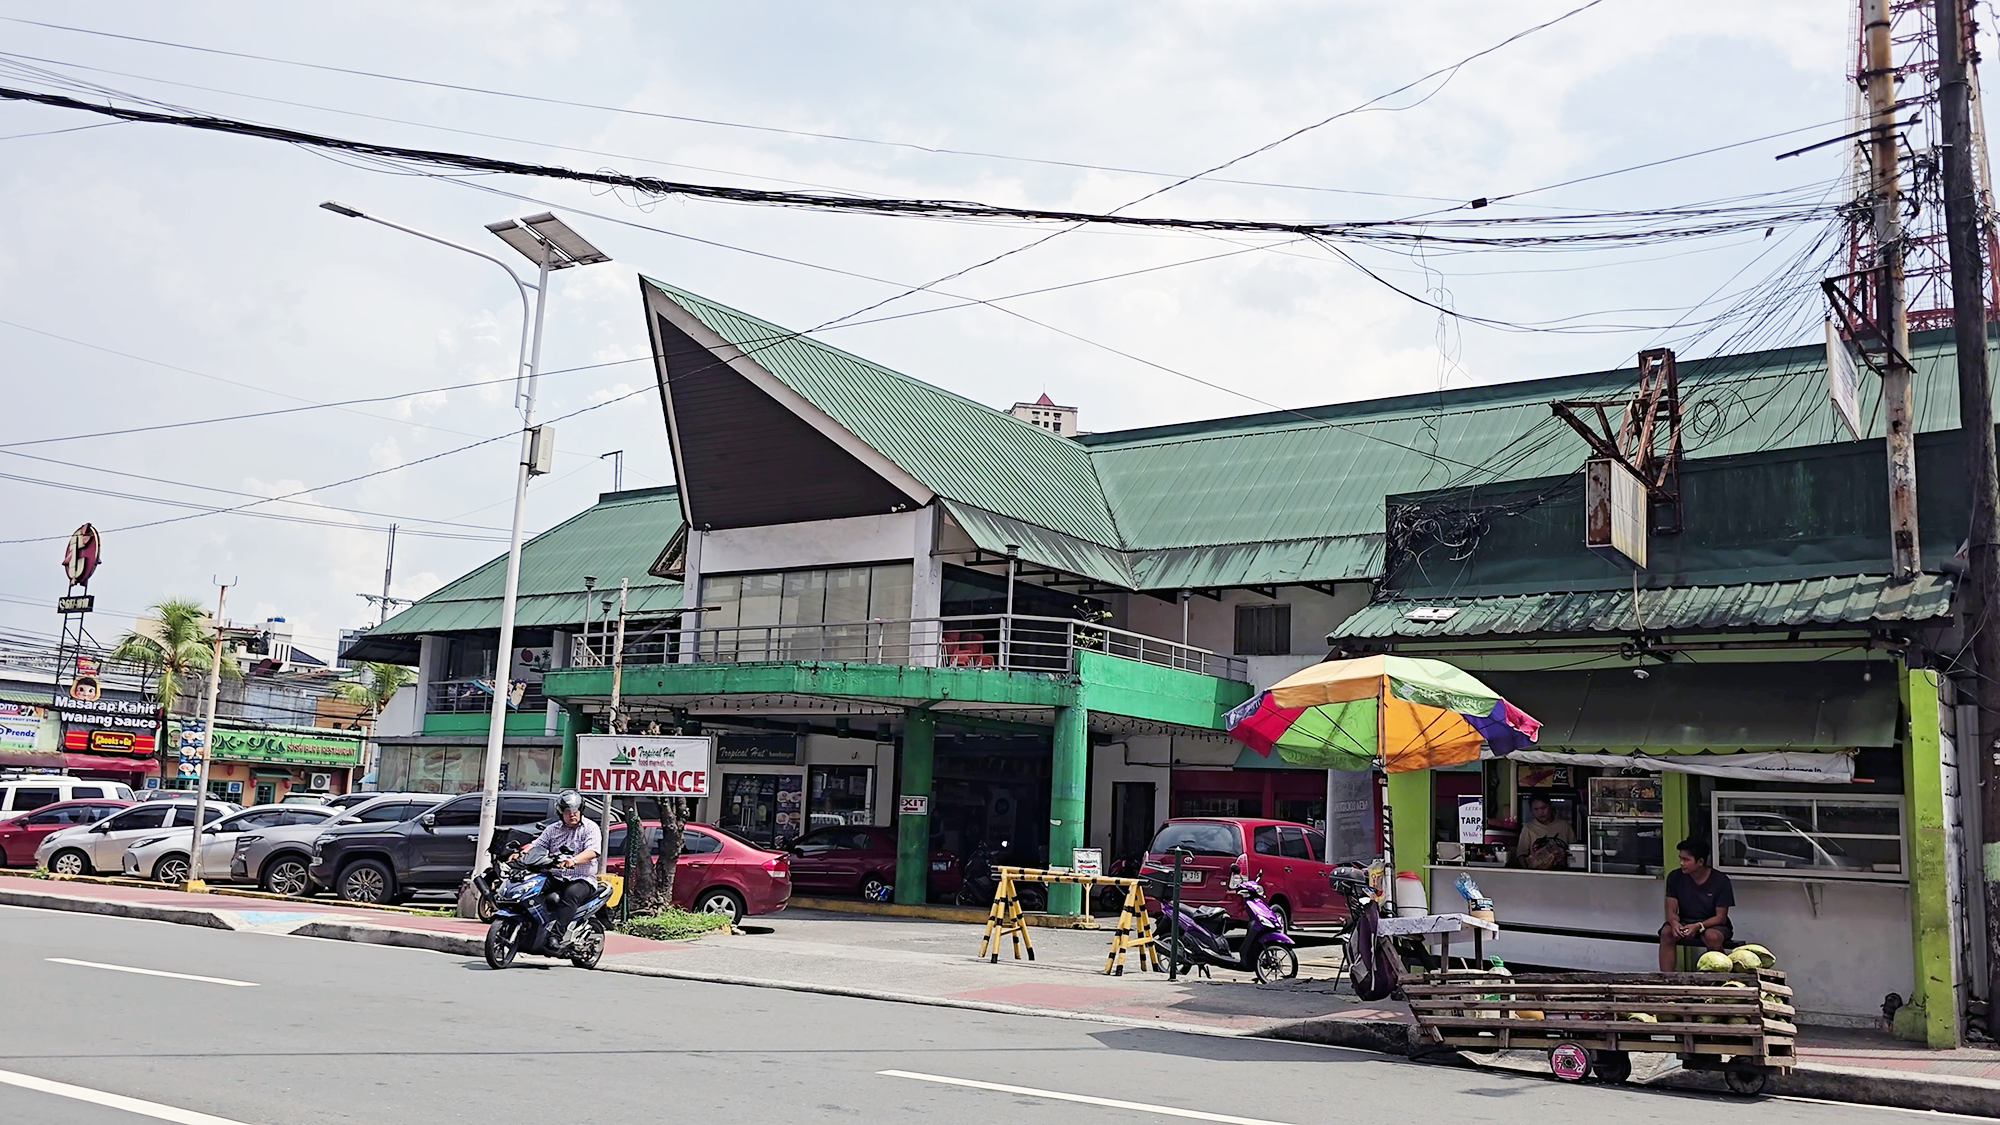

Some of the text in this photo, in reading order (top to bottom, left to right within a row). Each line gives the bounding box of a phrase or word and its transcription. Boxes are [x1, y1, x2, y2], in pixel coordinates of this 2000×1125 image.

[54, 695, 156, 715] Masarap Kahit
[114, 716, 157, 729] Sauce
[5, 728, 35, 738] Prendz
[637, 746, 676, 759] Tropical Hut
[719, 746, 749, 758] Tropical
[750, 747, 766, 757] Hut
[580, 768, 706, 793] ENTRANCE
